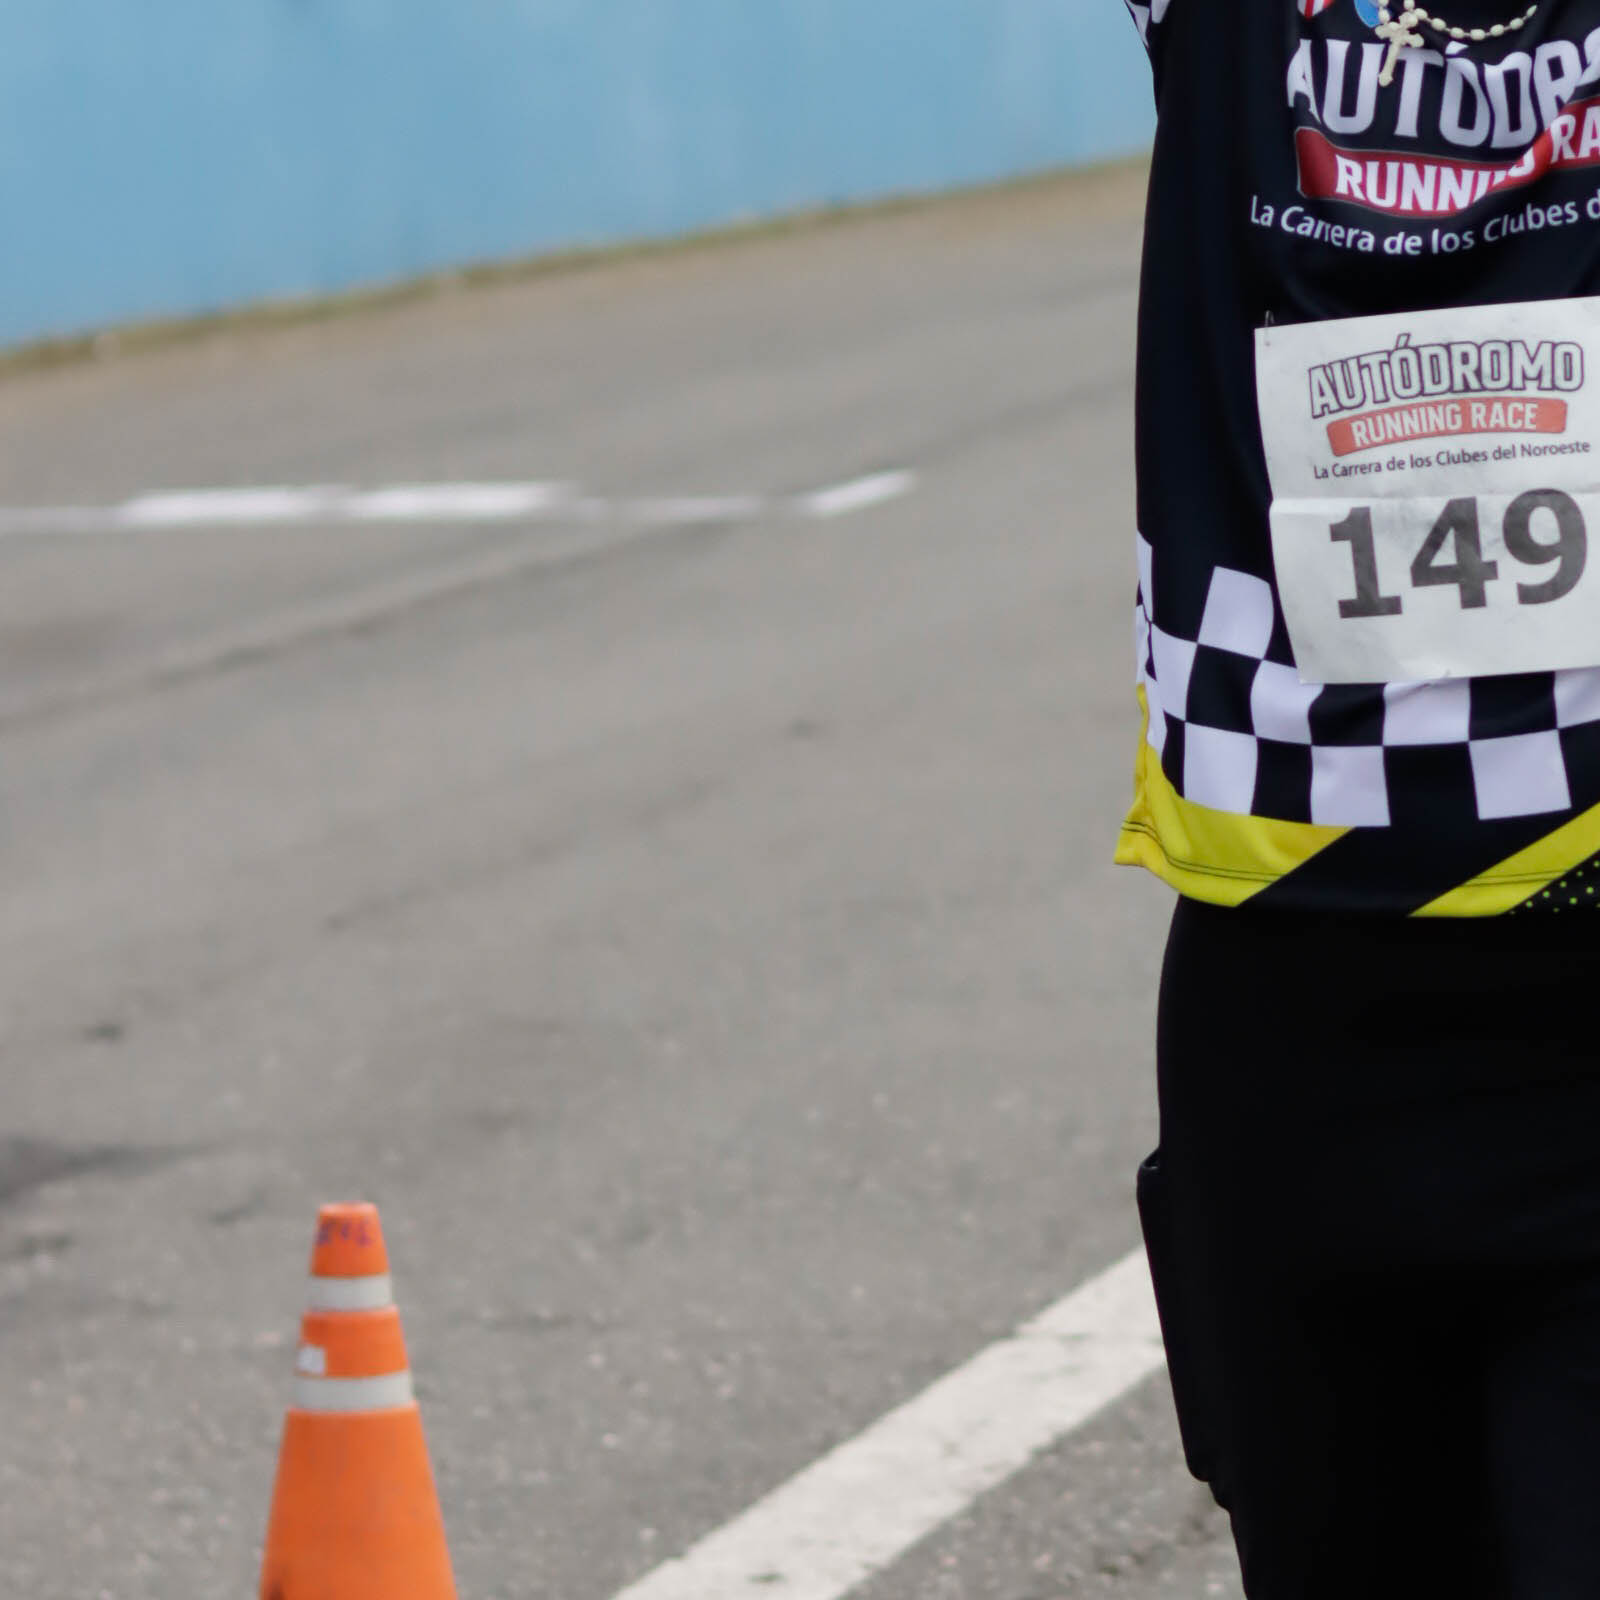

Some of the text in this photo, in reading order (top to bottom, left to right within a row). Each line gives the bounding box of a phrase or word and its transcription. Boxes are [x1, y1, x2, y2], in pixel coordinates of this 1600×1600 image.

[1250, 195, 1275, 228] La
[1280, 205, 1376, 253] Carrera
[1383, 231, 1423, 256] de
[1431, 228, 1475, 254] los
[1484, 201, 1579, 243] Clubes
[1307, 333, 1585, 419] AUTÓDROMO
[1350, 401, 1538, 449] RUNNING RACE
[1313, 439, 1591, 480] La Carrera de los Clubes del Noroeste
[1328, 487, 1588, 620] 149
